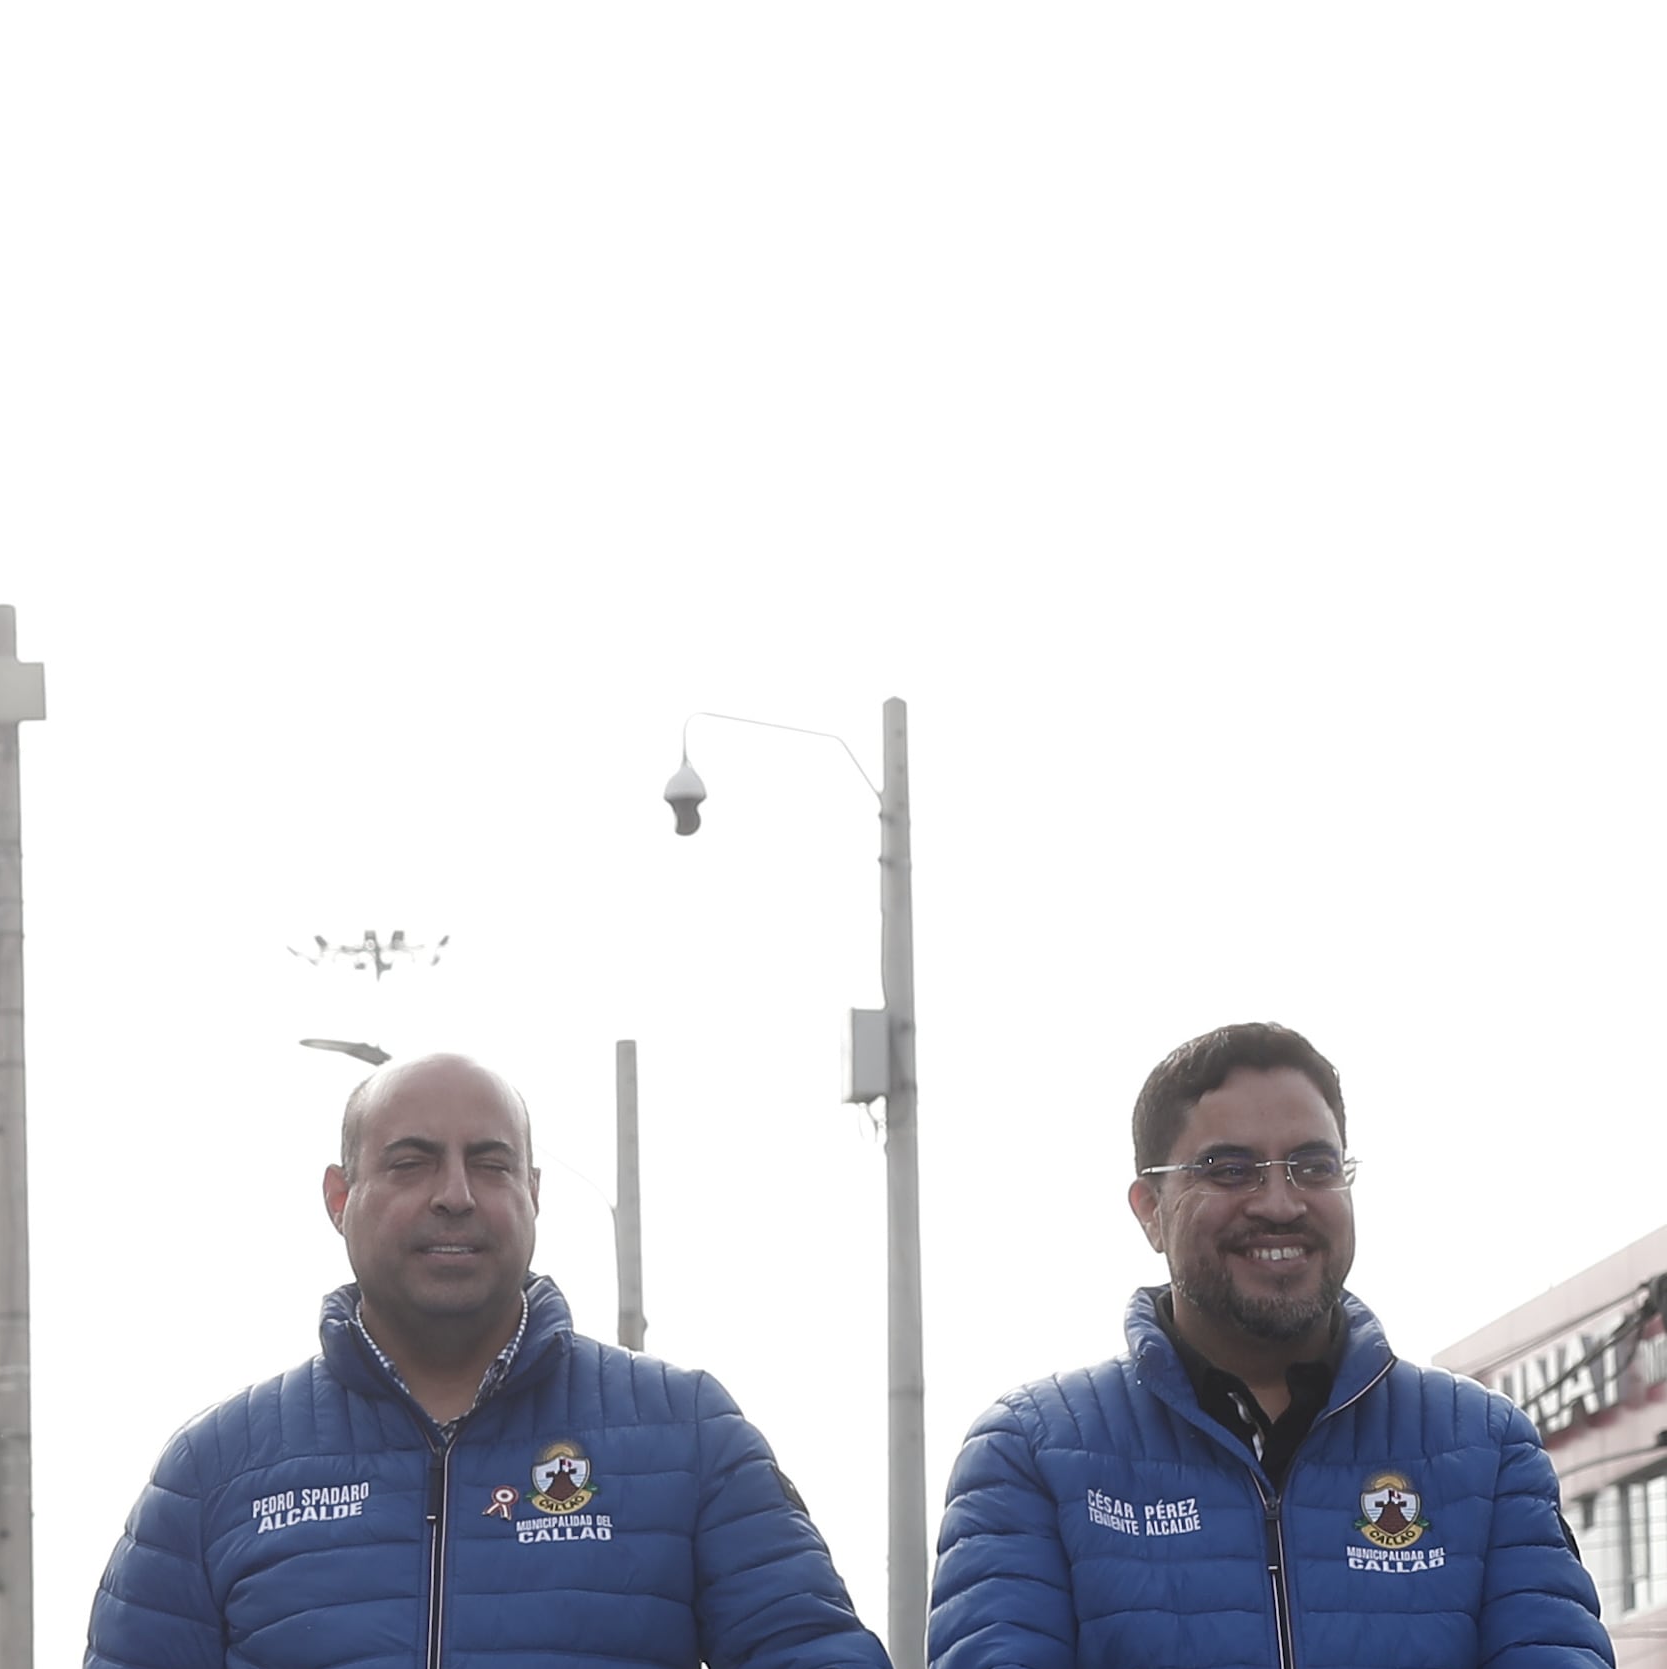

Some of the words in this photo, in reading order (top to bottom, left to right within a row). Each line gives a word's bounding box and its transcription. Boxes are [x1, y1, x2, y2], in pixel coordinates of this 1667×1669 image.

[253, 1491, 295, 1519] PEDRO
[301, 1482, 369, 1506] SPADARO
[538, 1496, 585, 1512] CALLAO
[1087, 1488, 1135, 1519] CÉSAR
[1144, 1498, 1198, 1520] PÉREZ
[257, 1501, 363, 1534] ALCALDE
[516, 1514, 593, 1532] MUNICIPALIDAD
[596, 1514, 614, 1528] DEL
[1088, 1506, 1140, 1536] TENIENTE
[1146, 1514, 1201, 1536] ALCALDE
[518, 1526, 612, 1544] CALLAO
[1369, 1529, 1416, 1545] CALLAO
[1346, 1546, 1424, 1562] MUNICIPALIDAD
[1428, 1546, 1446, 1559] DEL
[1348, 1556, 1445, 1573] CALLAO
